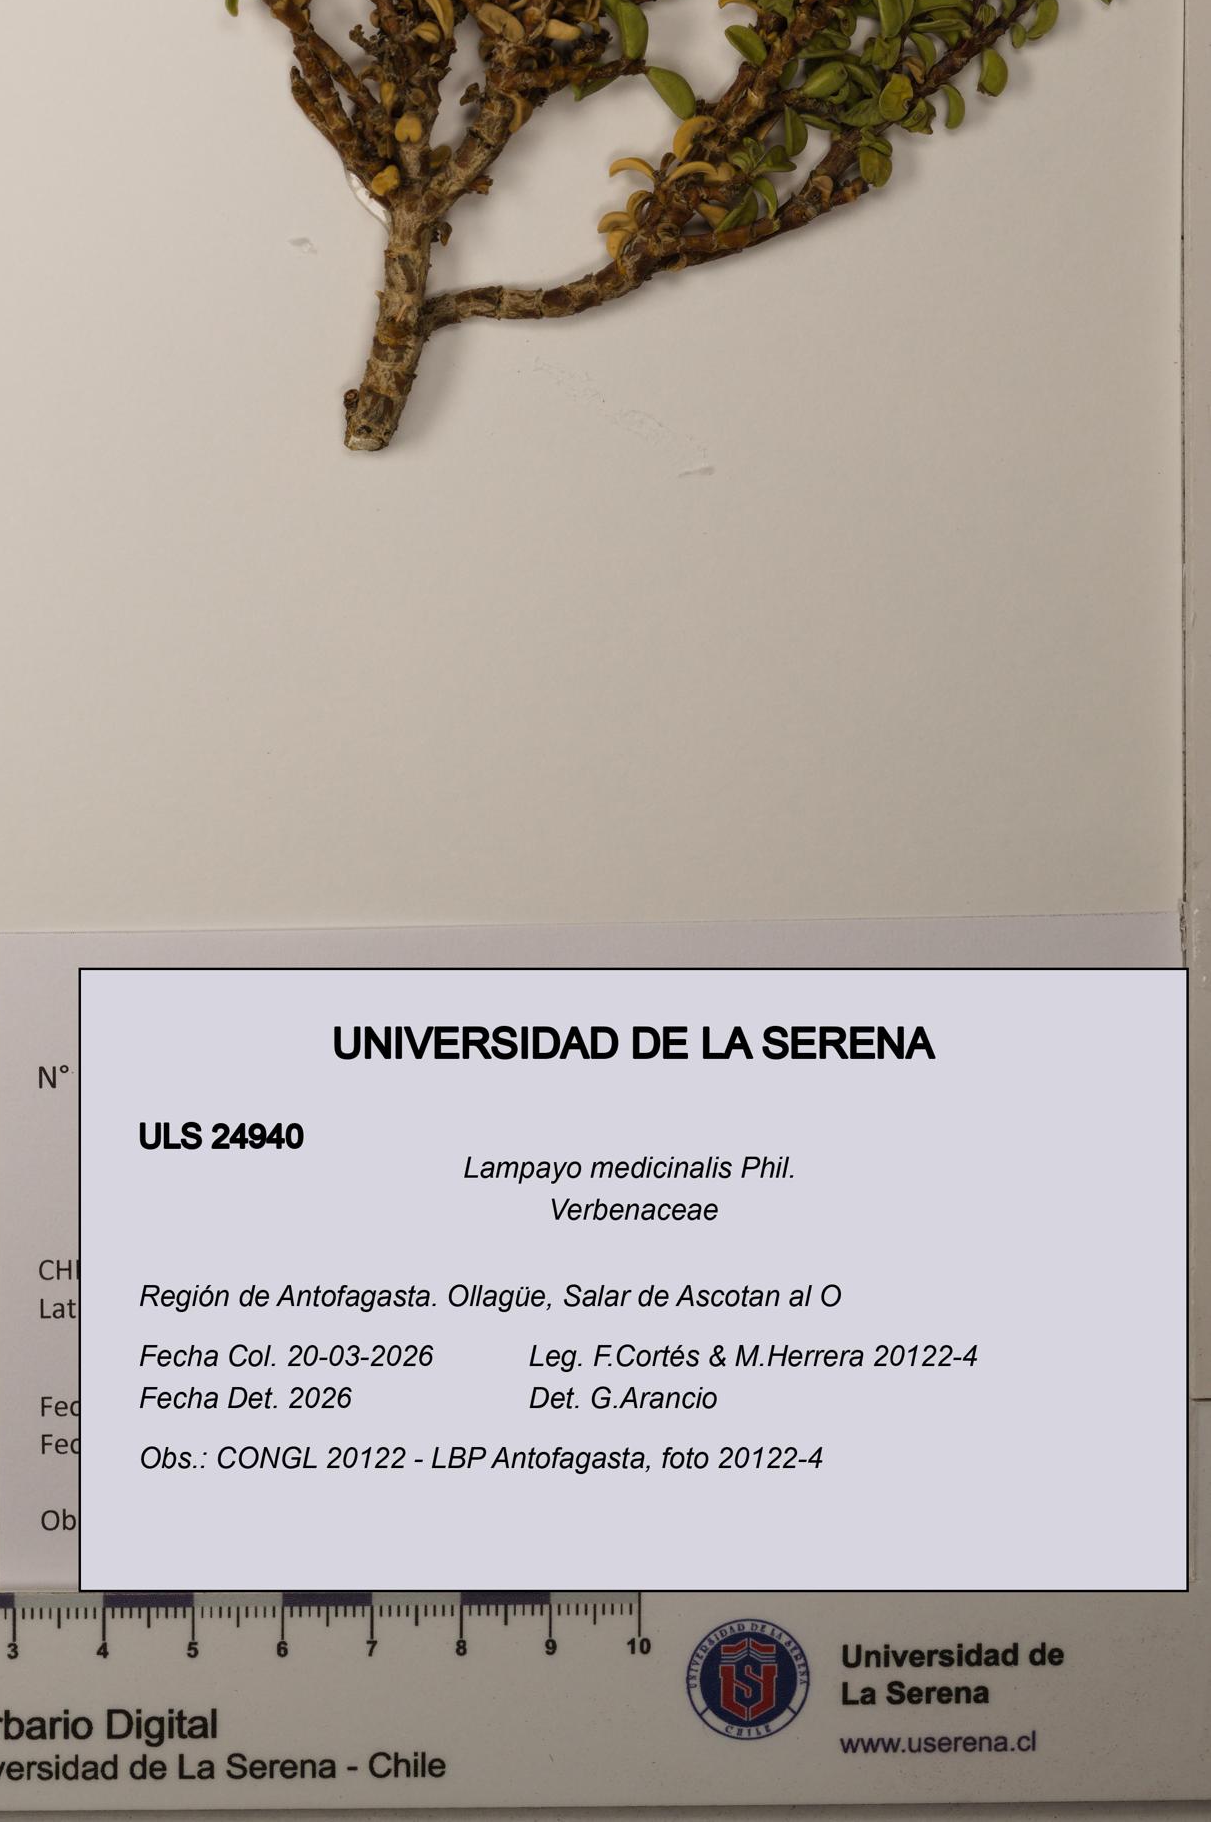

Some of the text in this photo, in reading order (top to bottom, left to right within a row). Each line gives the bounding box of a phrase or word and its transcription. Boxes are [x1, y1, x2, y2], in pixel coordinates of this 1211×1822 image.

[6, 1642, 19, 1660] 3
[96, 1642, 110, 1659] 4
[186, 1641, 200, 1659] 5
[276, 1640, 289, 1658] 6
[365, 1640, 378, 1657] 7
[455, 1639, 468, 1657] 8
[544, 1638, 558, 1656] 9
[626, 1638, 652, 1656] 10
[841, 1641, 1065, 1669] Universidad de
[841, 1680, 990, 1706] La Serena
[106, 1706, 218, 1748] Digital
[839, 1729, 1038, 1755] www.userena.cl
[129, 1753, 168, 1781] de
[178, 1753, 215, 1780] La
[225, 1752, 337, 1780] Serena
[368, 1751, 447, 1779] Chile
